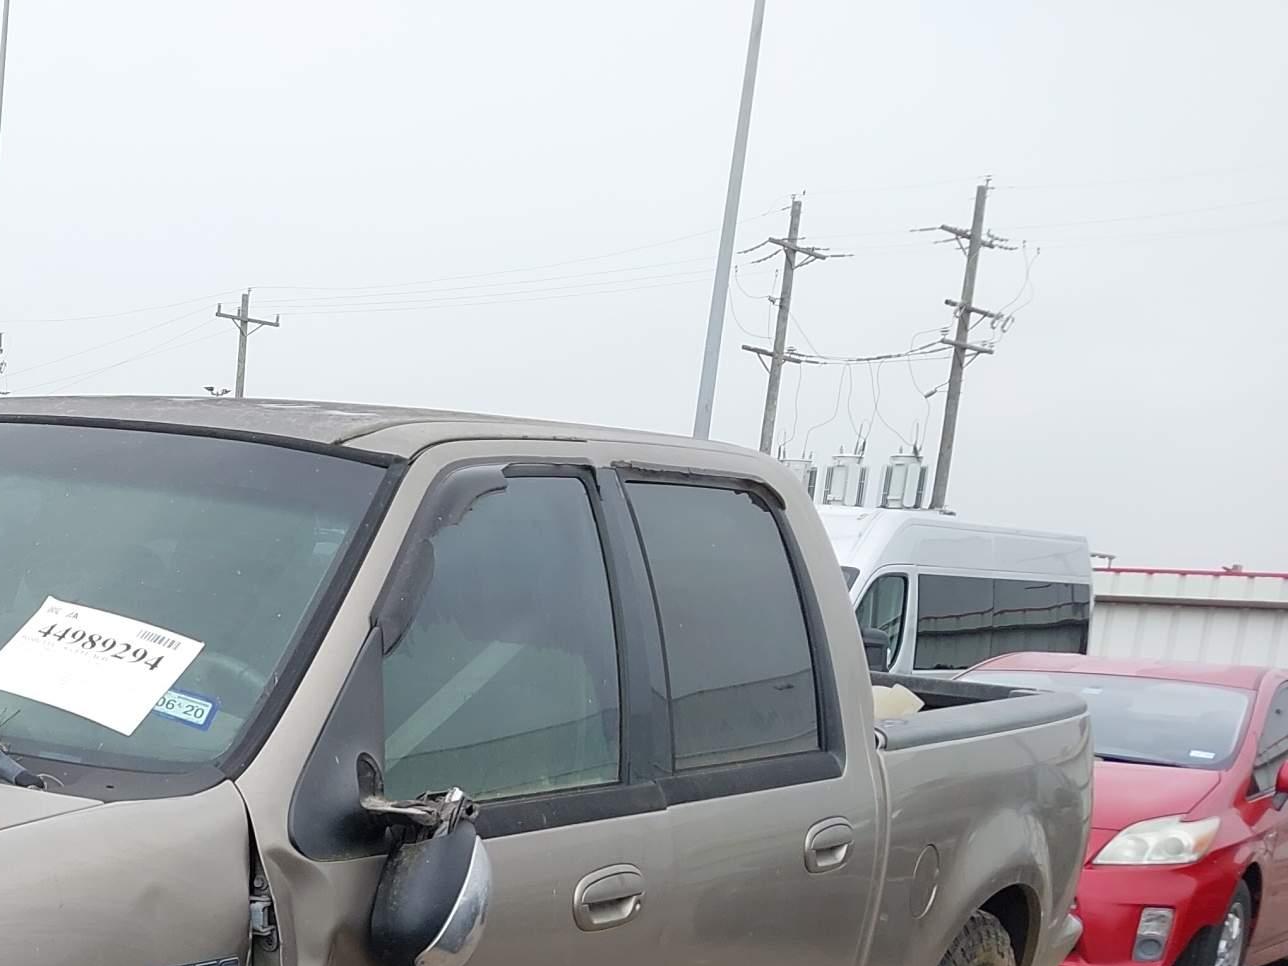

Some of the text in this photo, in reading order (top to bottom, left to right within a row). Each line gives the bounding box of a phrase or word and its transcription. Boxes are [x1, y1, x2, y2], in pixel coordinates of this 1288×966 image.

[37, 622, 165, 671] 44989294
[155, 696, 177, 710] 06
[182, 704, 206, 719] 20
